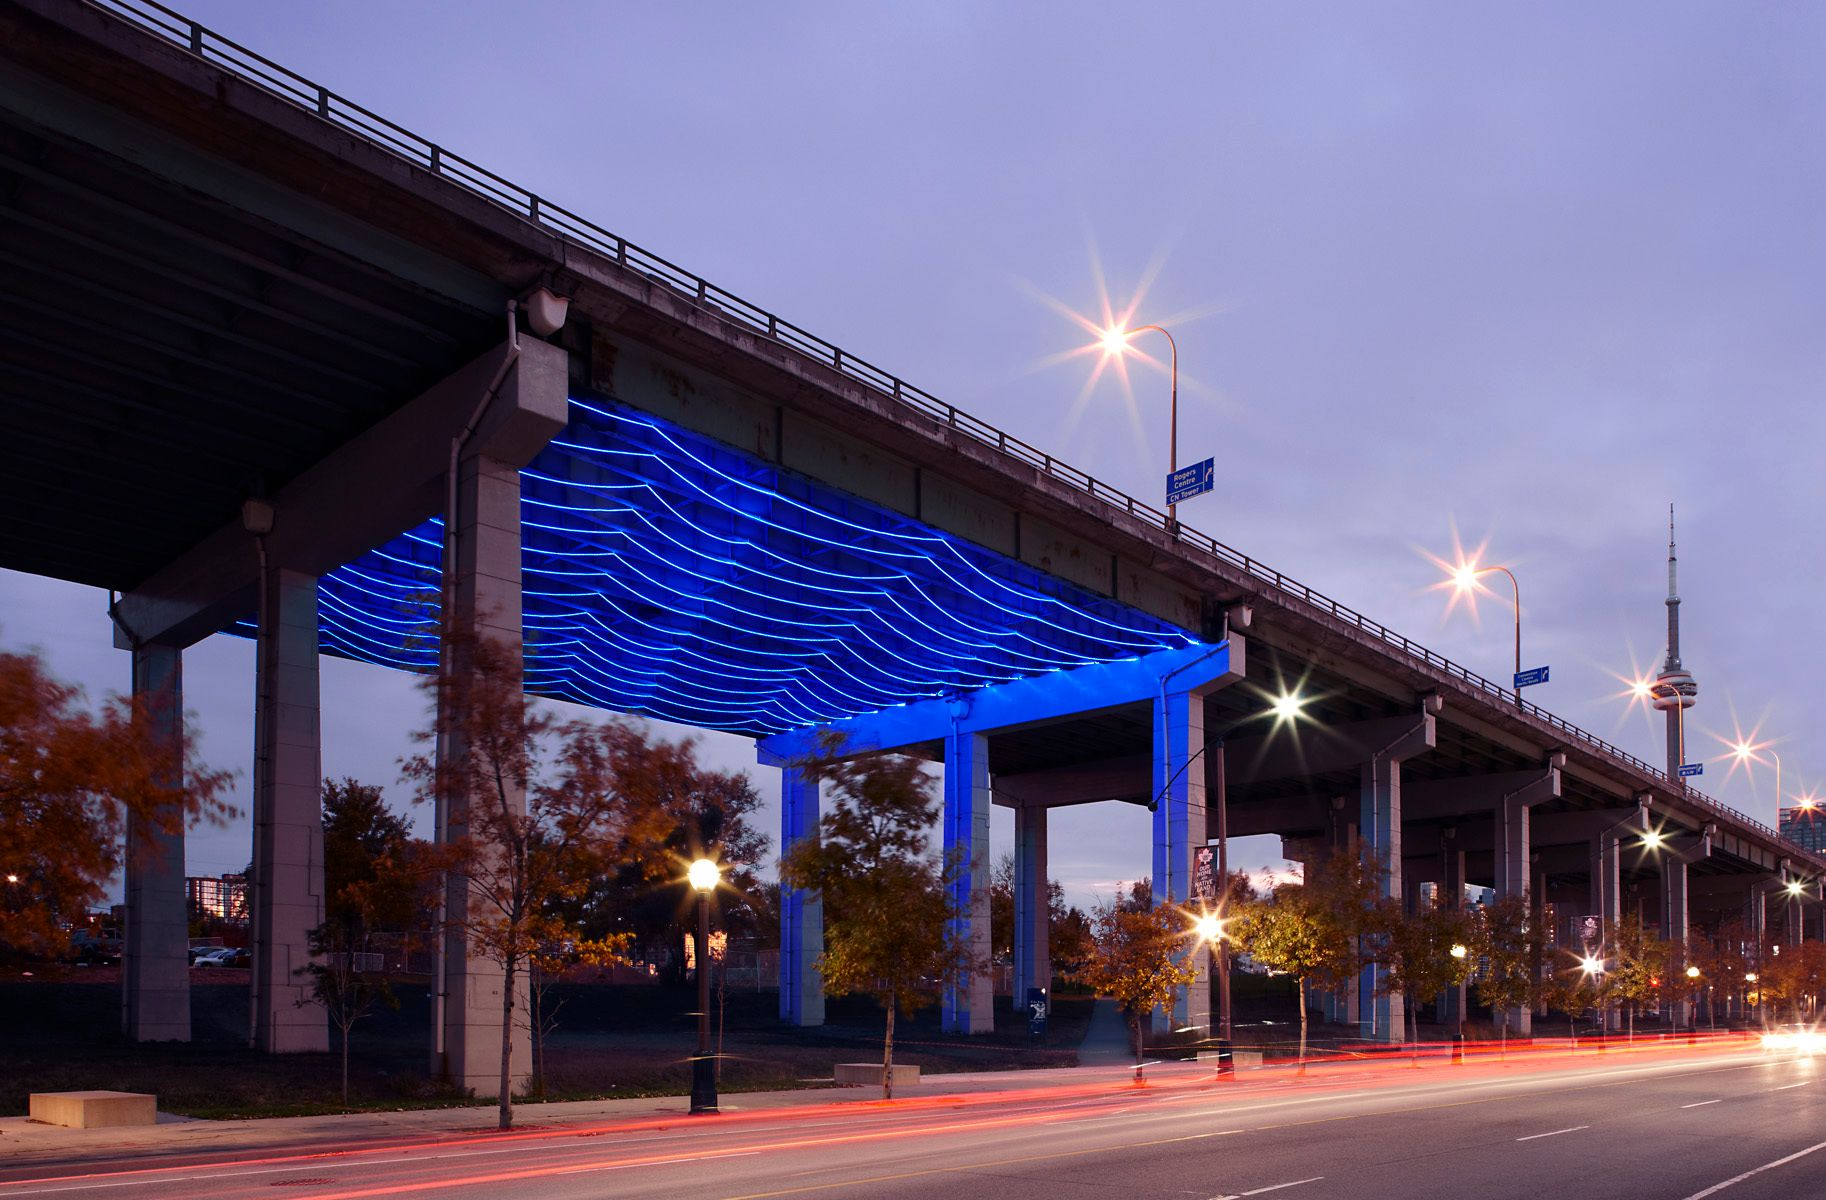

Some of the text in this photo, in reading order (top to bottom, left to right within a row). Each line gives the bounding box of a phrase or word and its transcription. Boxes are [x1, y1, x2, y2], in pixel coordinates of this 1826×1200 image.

[1174, 470, 1196, 482] Rogers
[1174, 477, 1196, 489] Centre
[1170, 487, 1199, 502] CN Tower
[1197, 869, 1212, 877] HOME
[1200, 864, 1210, 872] OUR
[1194, 879, 1213, 888] NATIVE
